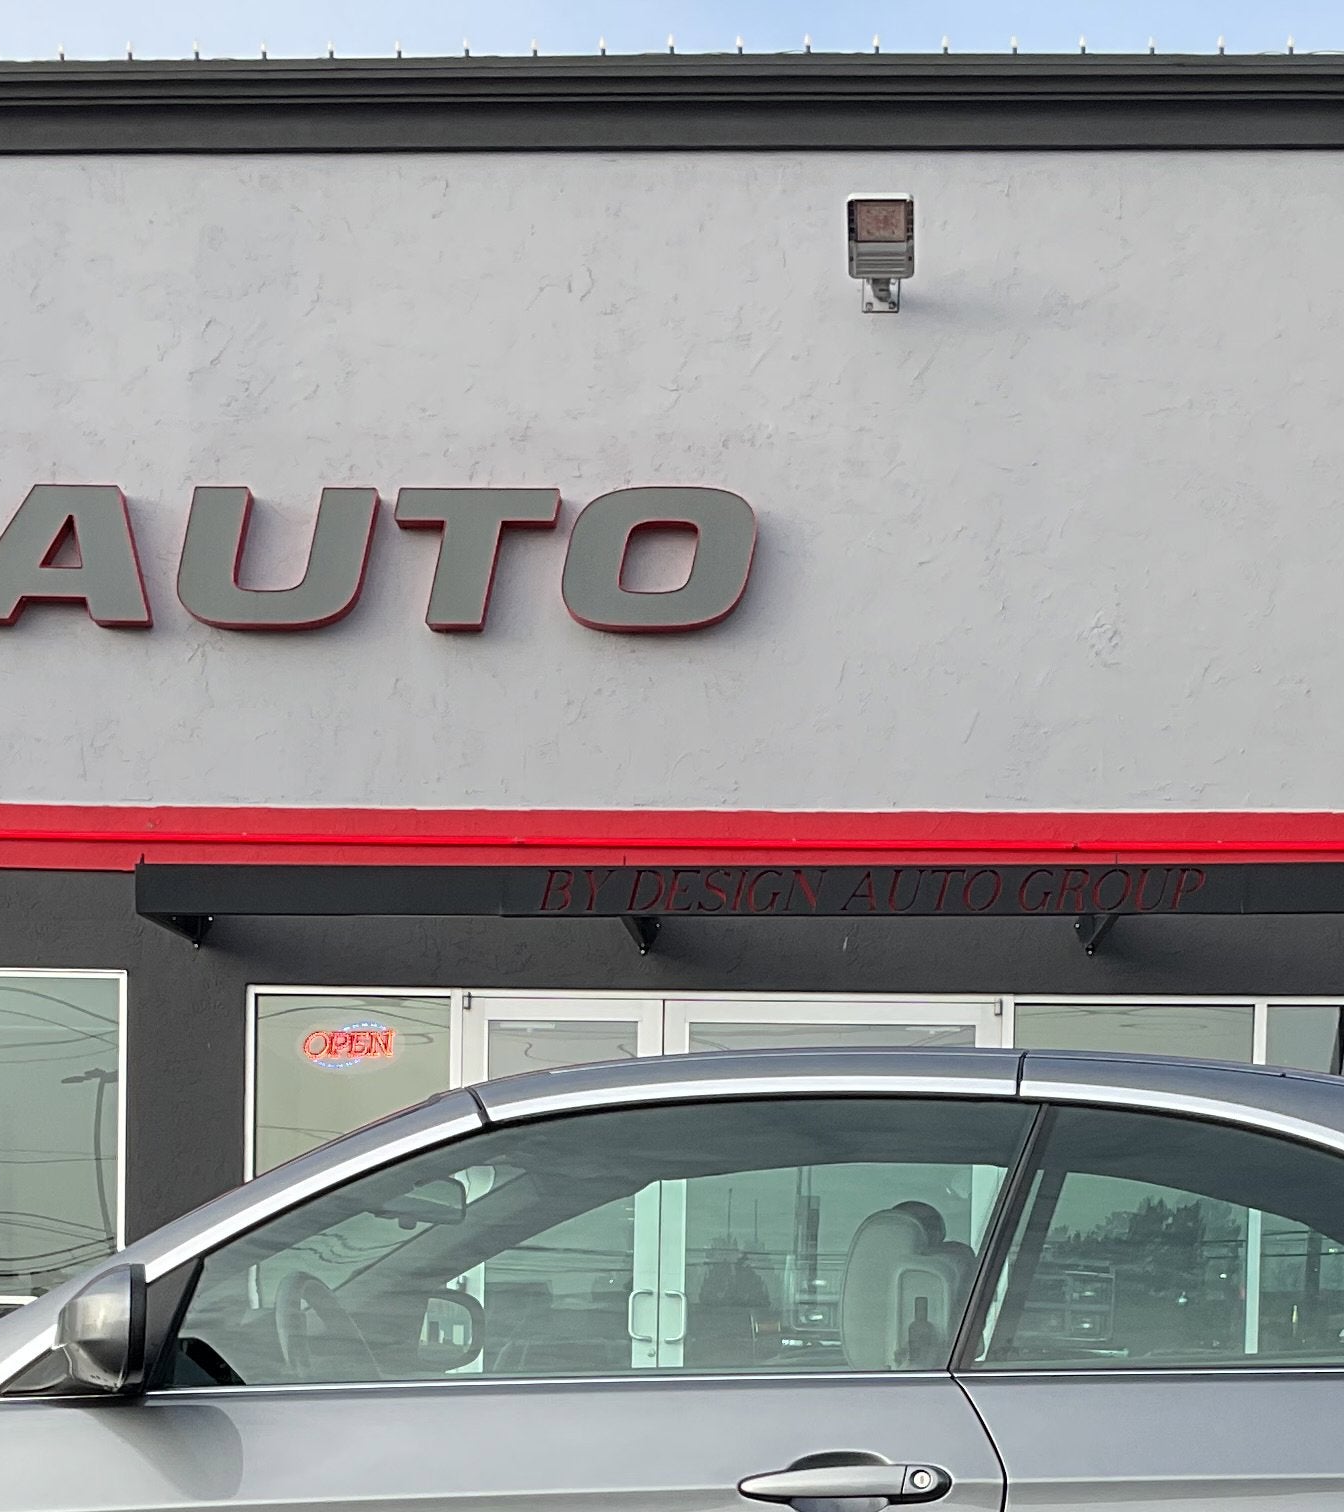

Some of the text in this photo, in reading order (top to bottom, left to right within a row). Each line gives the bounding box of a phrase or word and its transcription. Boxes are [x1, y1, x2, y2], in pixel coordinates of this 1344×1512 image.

[539, 867, 1207, 912] BY DESIGN AUTO GROUP
[303, 1029, 395, 1060] OPEN
